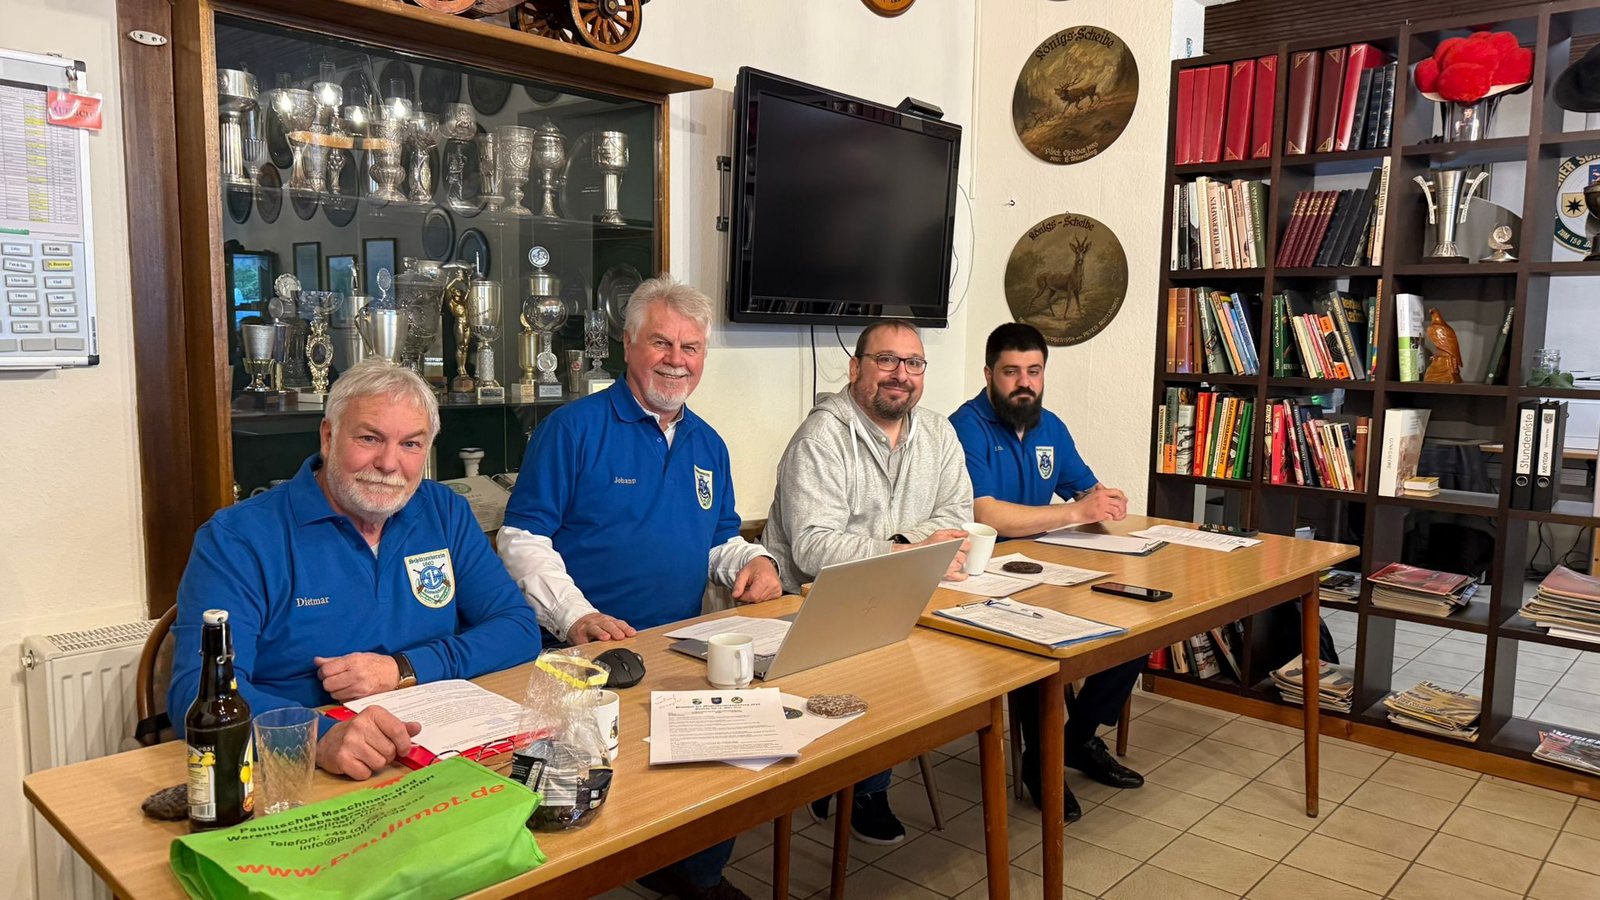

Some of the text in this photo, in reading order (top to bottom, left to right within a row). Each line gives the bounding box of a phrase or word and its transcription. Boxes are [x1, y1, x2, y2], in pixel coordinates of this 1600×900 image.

[1520, 413, 1533, 469] Stundenliste
[614, 476, 637, 484] Johann
[409, 775, 435, 791] mbH
[322, 793, 393, 817] Maschinen-
[395, 779, 417, 792] und
[236, 783, 505, 877] www.paulimot.de
[269, 835, 320, 847] Telefon:
